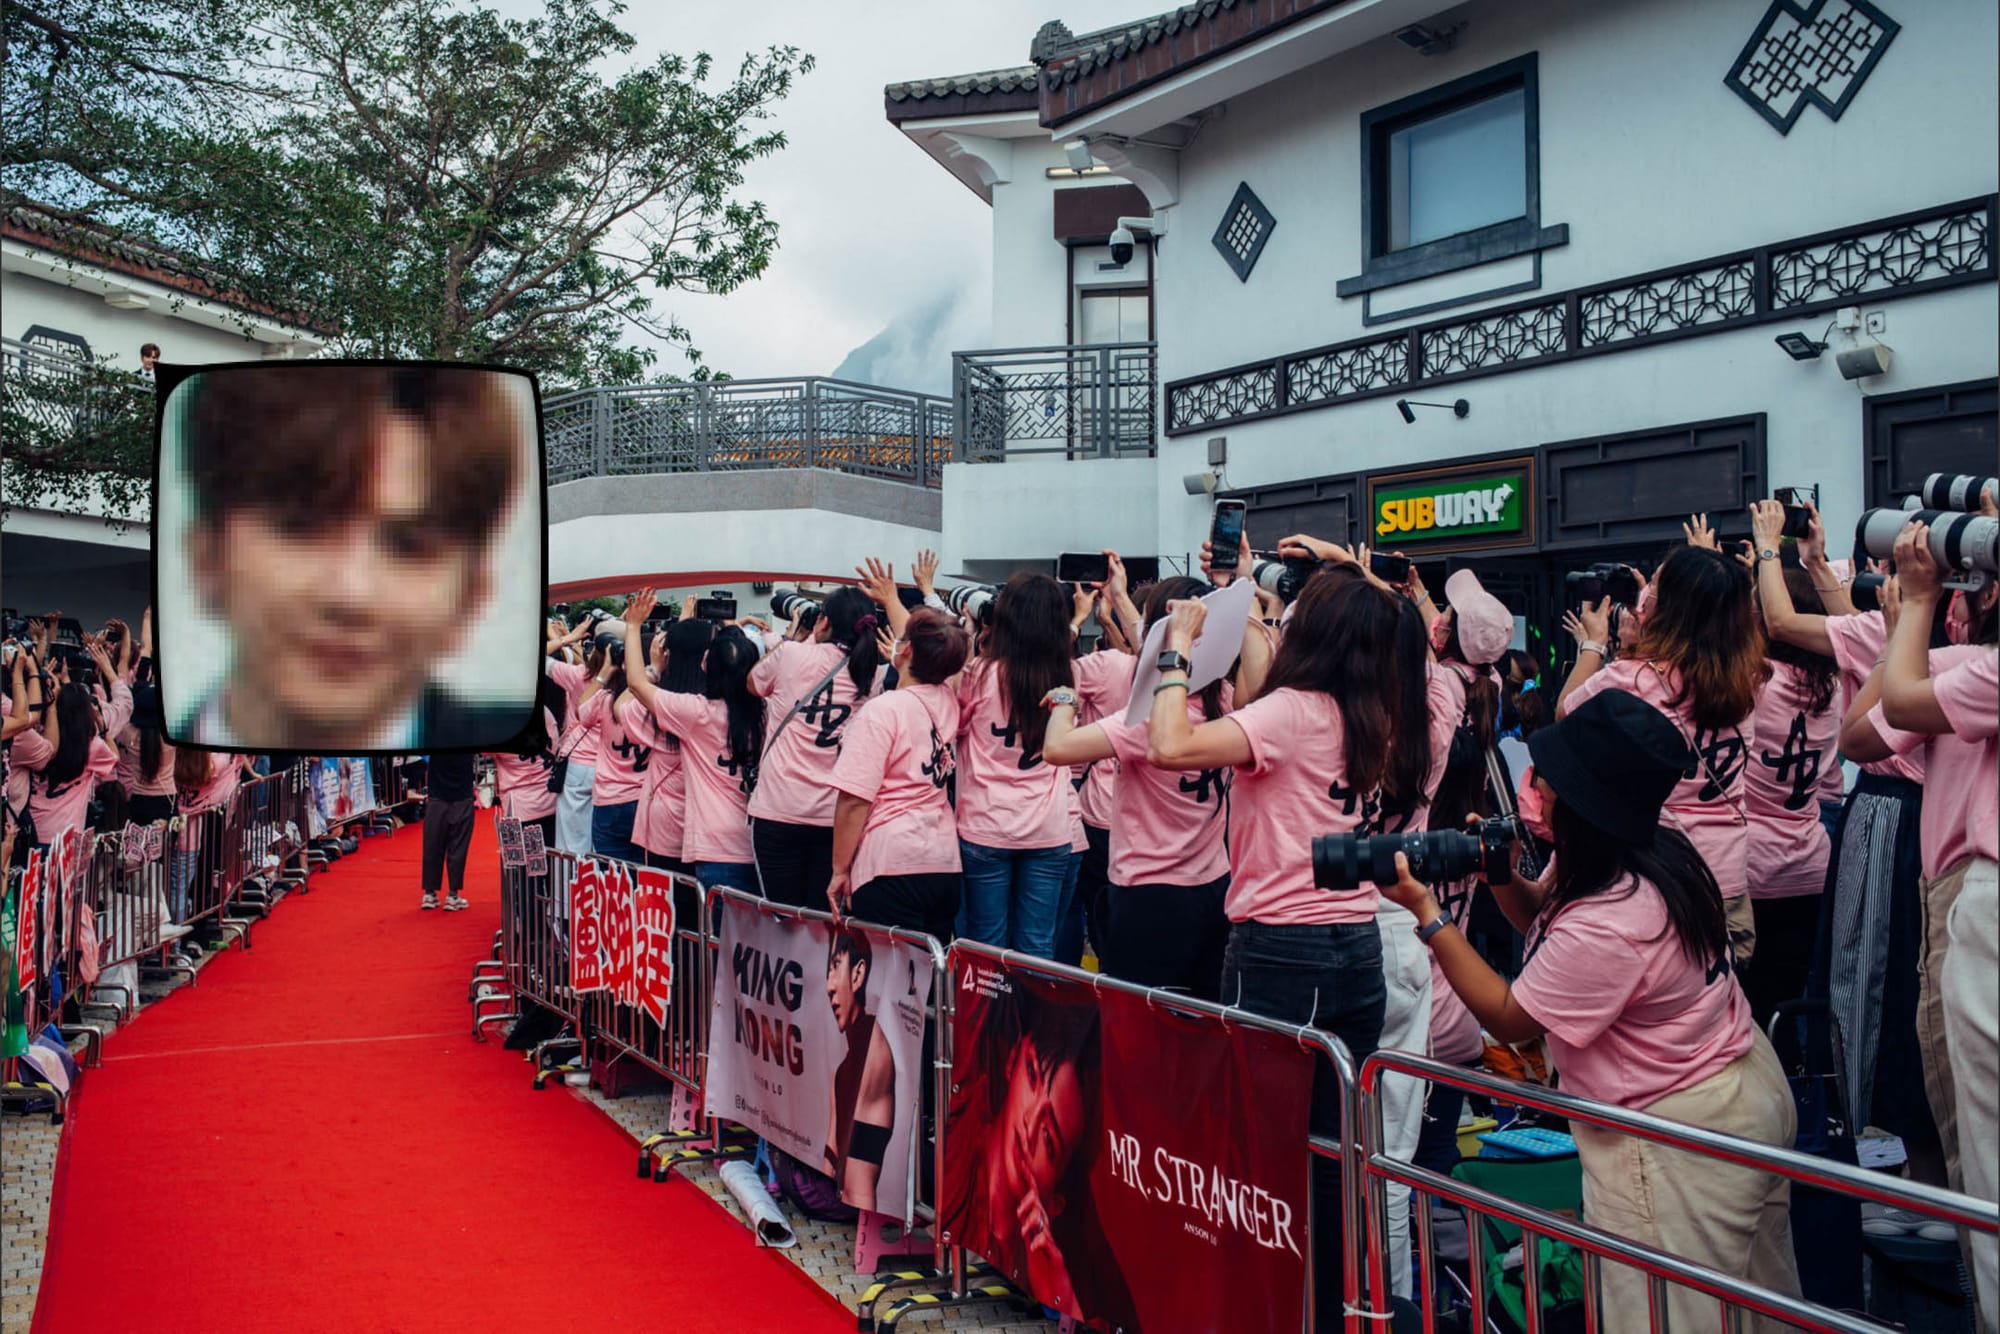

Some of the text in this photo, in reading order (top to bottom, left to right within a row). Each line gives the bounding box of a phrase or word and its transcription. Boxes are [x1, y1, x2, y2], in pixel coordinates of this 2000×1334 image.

[1376, 483, 1514, 536] SUBWAY
[733, 942, 803, 1012] KING
[735, 998, 804, 1076] KONG
[1108, 1129, 1303, 1262] MR. STRANGER
[1184, 1221, 1209, 1241] ANSON
